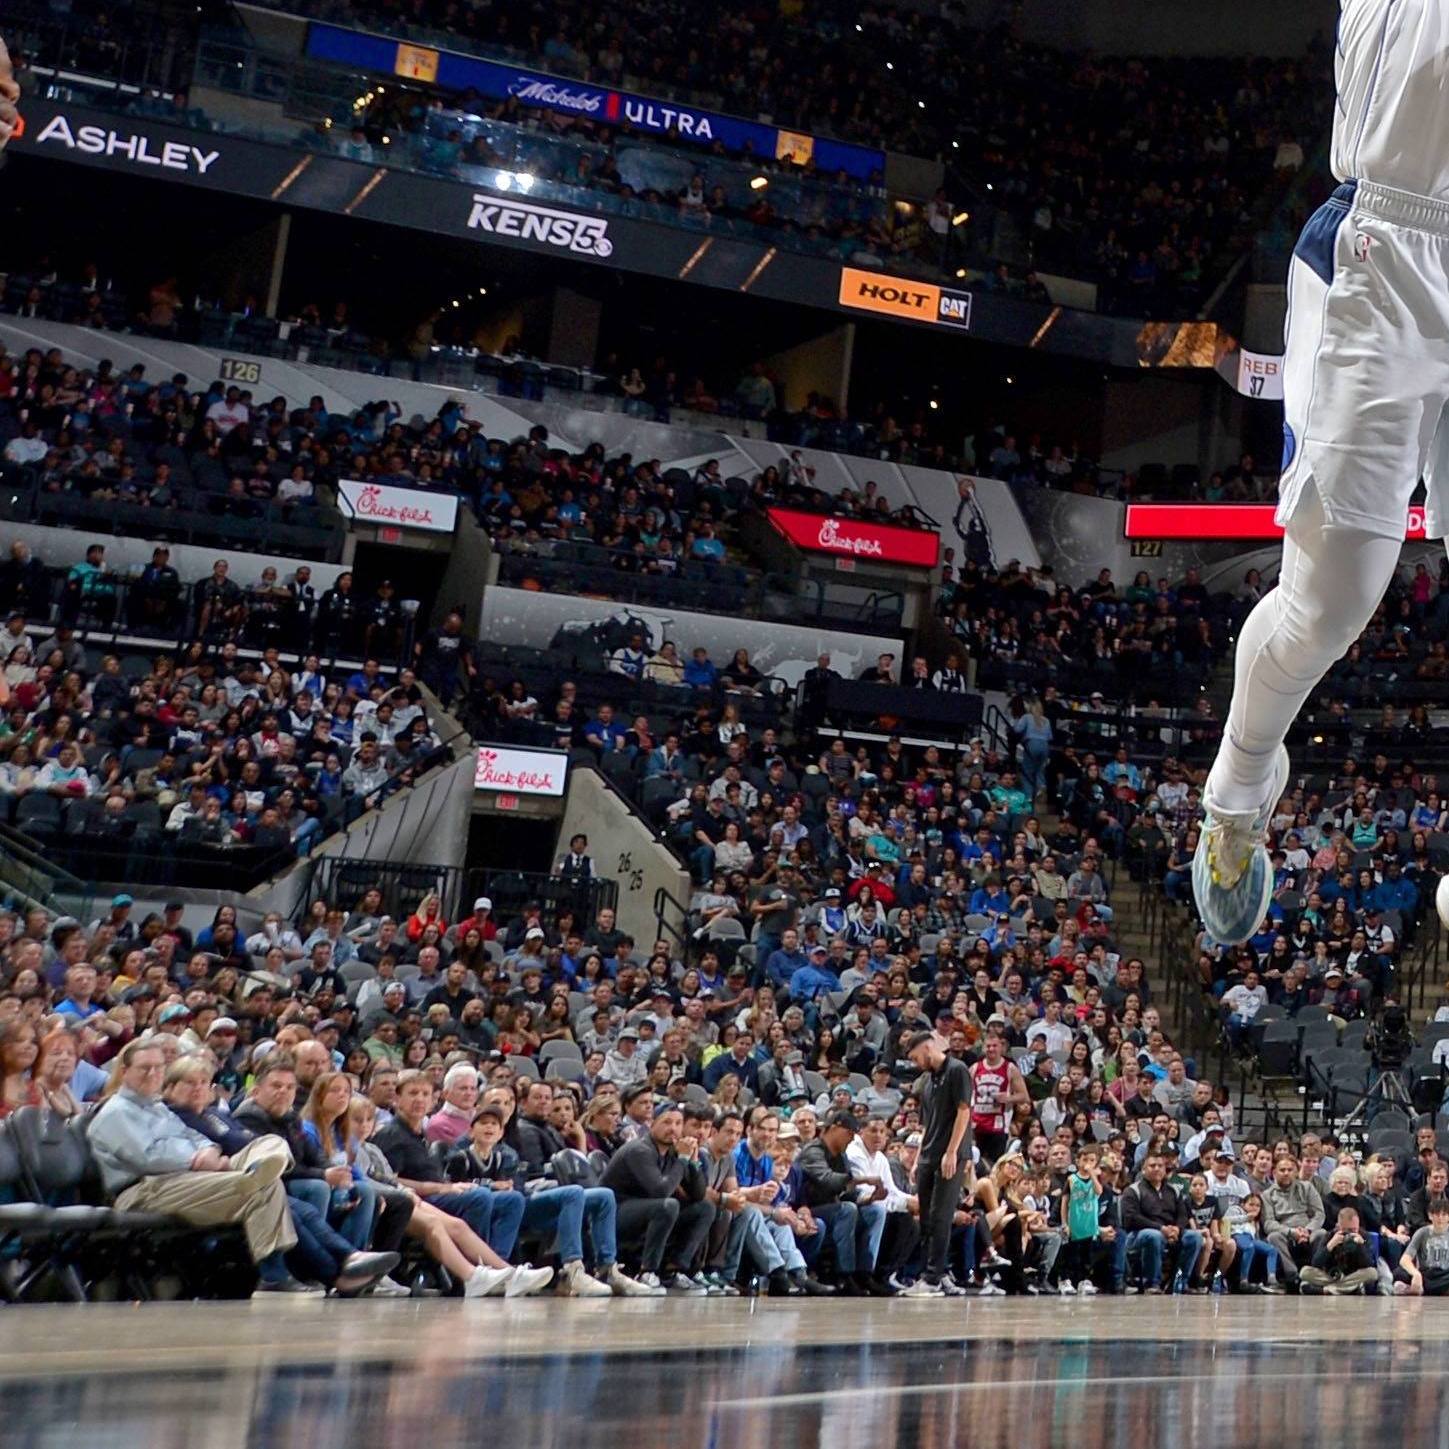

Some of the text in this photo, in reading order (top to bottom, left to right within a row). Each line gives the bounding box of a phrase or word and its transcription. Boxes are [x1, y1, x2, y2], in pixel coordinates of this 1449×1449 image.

[507, 76, 713, 140] Michelob ULTRA
[36, 115, 220, 174] ASHLEY
[859, 282, 968, 319] HOLT CAT
[223, 360, 258, 383] 126
[1243, 358, 1277, 375] REB
[1250, 377, 1265, 396] 37
[1135, 541, 1161, 556] 127
[617, 852, 632, 873] 26
[629, 868, 644, 891] 25
